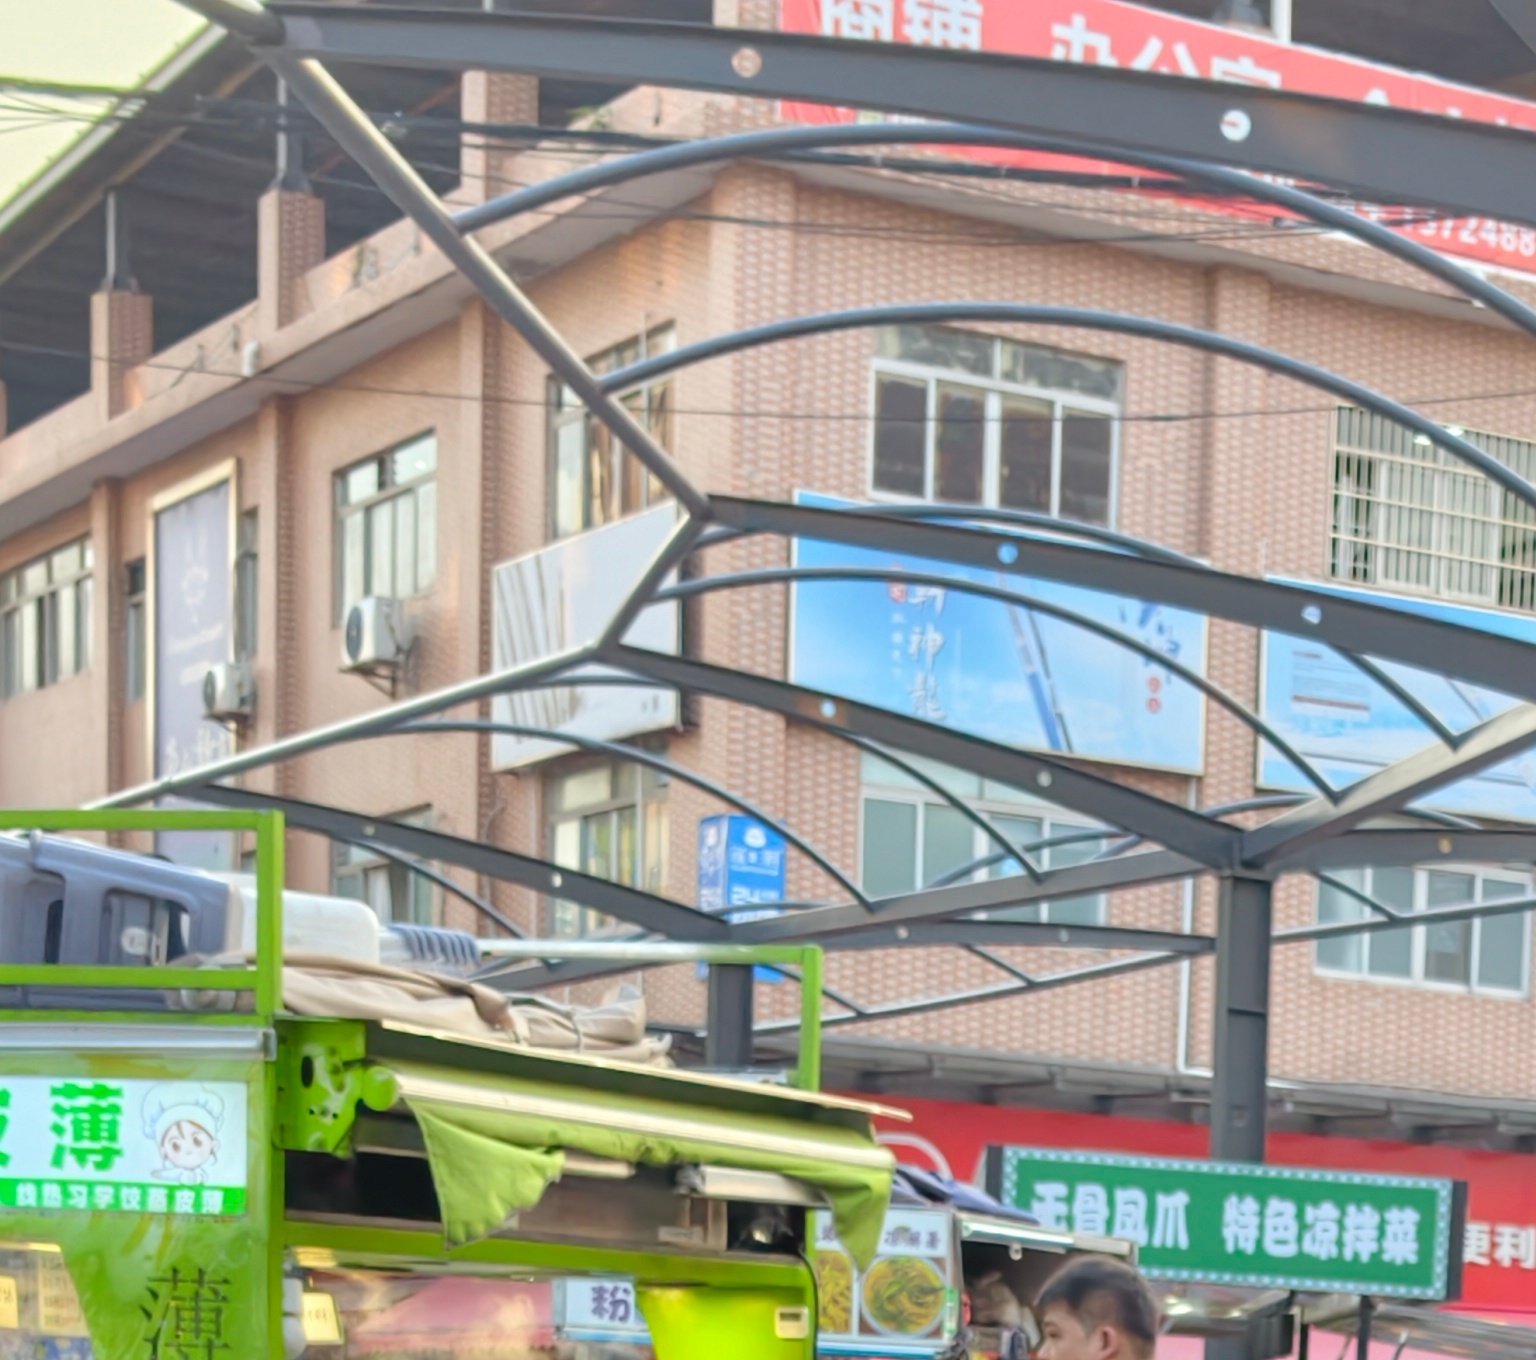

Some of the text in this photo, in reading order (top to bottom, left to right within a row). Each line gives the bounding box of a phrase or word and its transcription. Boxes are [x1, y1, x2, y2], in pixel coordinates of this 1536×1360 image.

[1222, 1193, 1421, 1266] 特色凉拌菜
[591, 1285, 631, 1323] 粉
